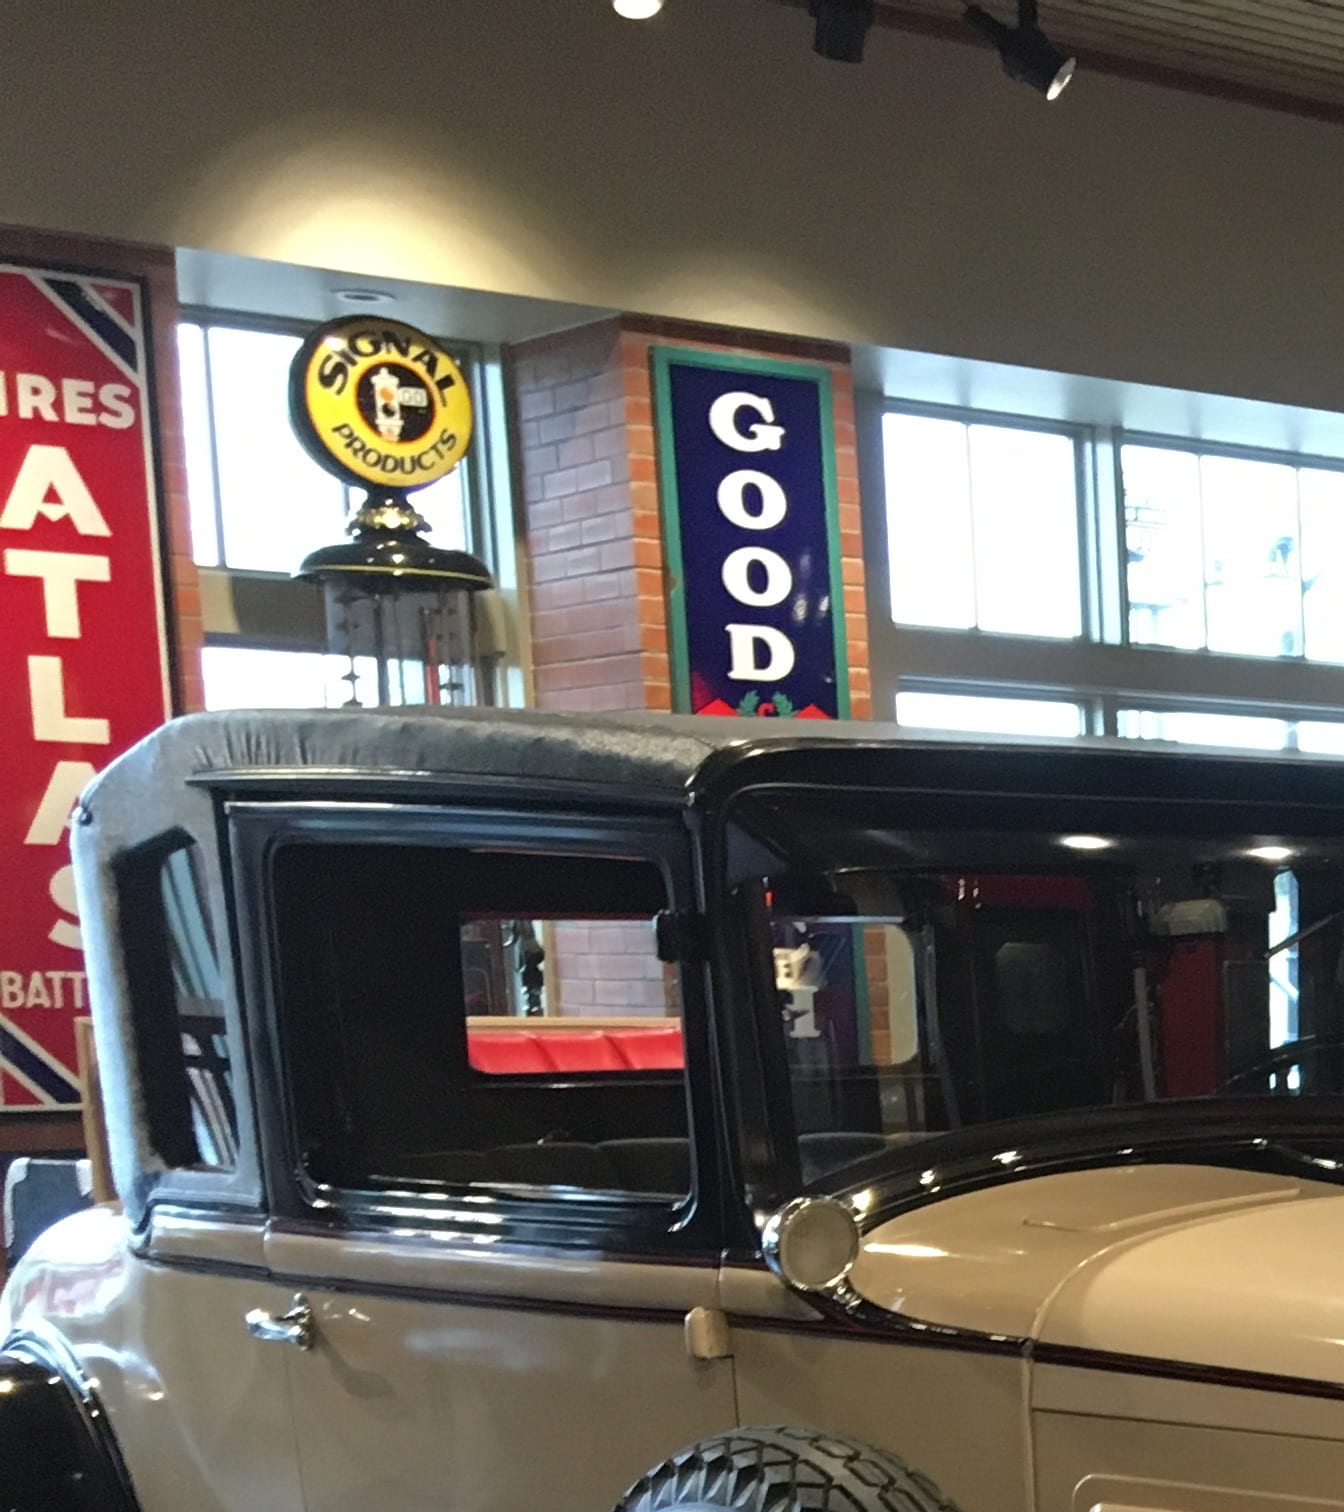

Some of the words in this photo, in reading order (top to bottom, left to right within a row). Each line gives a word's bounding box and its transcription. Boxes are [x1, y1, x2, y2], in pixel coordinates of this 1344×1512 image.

[318, 331, 456, 408] SIGNAL
[331, 423, 458, 475] PRODUCTS
[708, 391, 796, 682] GOOD
[0, 970, 89, 1010] BATT
